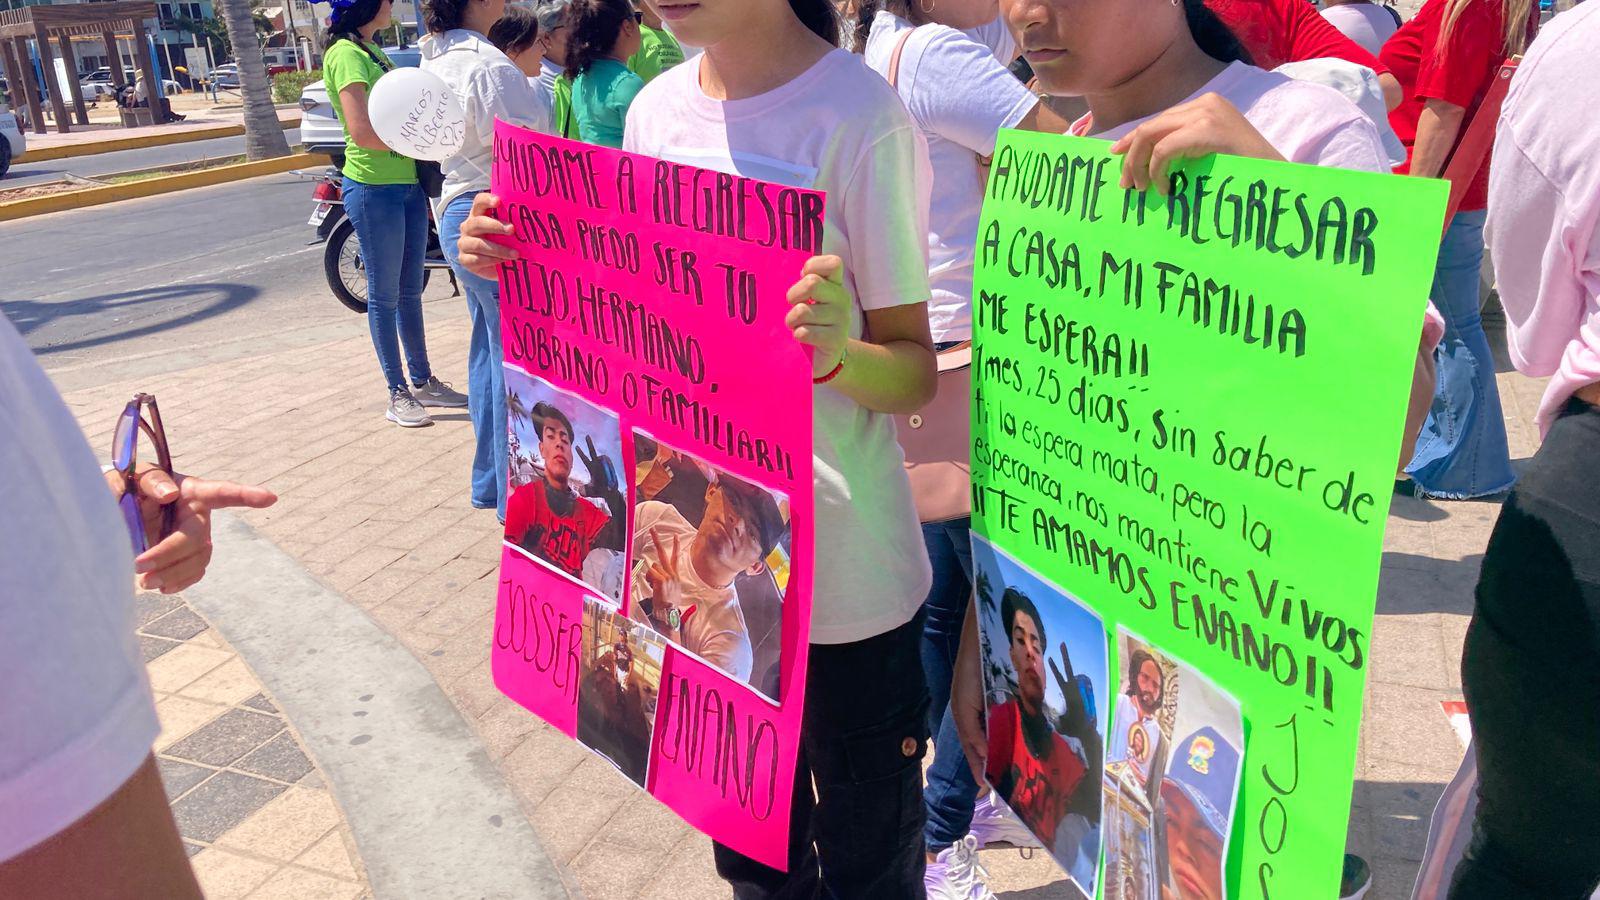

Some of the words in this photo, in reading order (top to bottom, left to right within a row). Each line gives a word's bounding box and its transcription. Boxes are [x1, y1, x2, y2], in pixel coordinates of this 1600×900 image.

[401, 88, 432, 141] MARCOS
[414, 91, 448, 155] ALBERTO
[493, 131, 608, 209] AYUDAME
[617, 156, 637, 214] A
[652, 159, 826, 255] REGRESAR
[992, 144, 1113, 223] AYUDAME
[1167, 170, 1380, 276] REGRESAR
[576, 218, 640, 275] PUEDO
[653, 241, 703, 305] SER
[715, 263, 758, 325] TU
[979, 289, 1008, 335] ME
[983, 219, 1000, 269] A
[1099, 251, 1143, 310] MI
[1153, 261, 1307, 358] FAMILIA
[511, 316, 609, 395] SOBRINO
[622, 372, 638, 409] O
[975, 388, 989, 424] ti
[1000, 400, 1016, 439] la
[1022, 420, 1083, 470] espera
[1173, 483, 1225, 529] pero
[1242, 504, 1272, 557] la
[1035, 366, 1060, 404] 25
[1323, 471, 1374, 525] de
[1032, 508, 1157, 610] AMAMOS
[1076, 490, 1108, 527] nos
[1118, 513, 1239, 601] mantiene
[497, 579, 583, 705] JOSSER
[660, 673, 779, 821] ENANO
